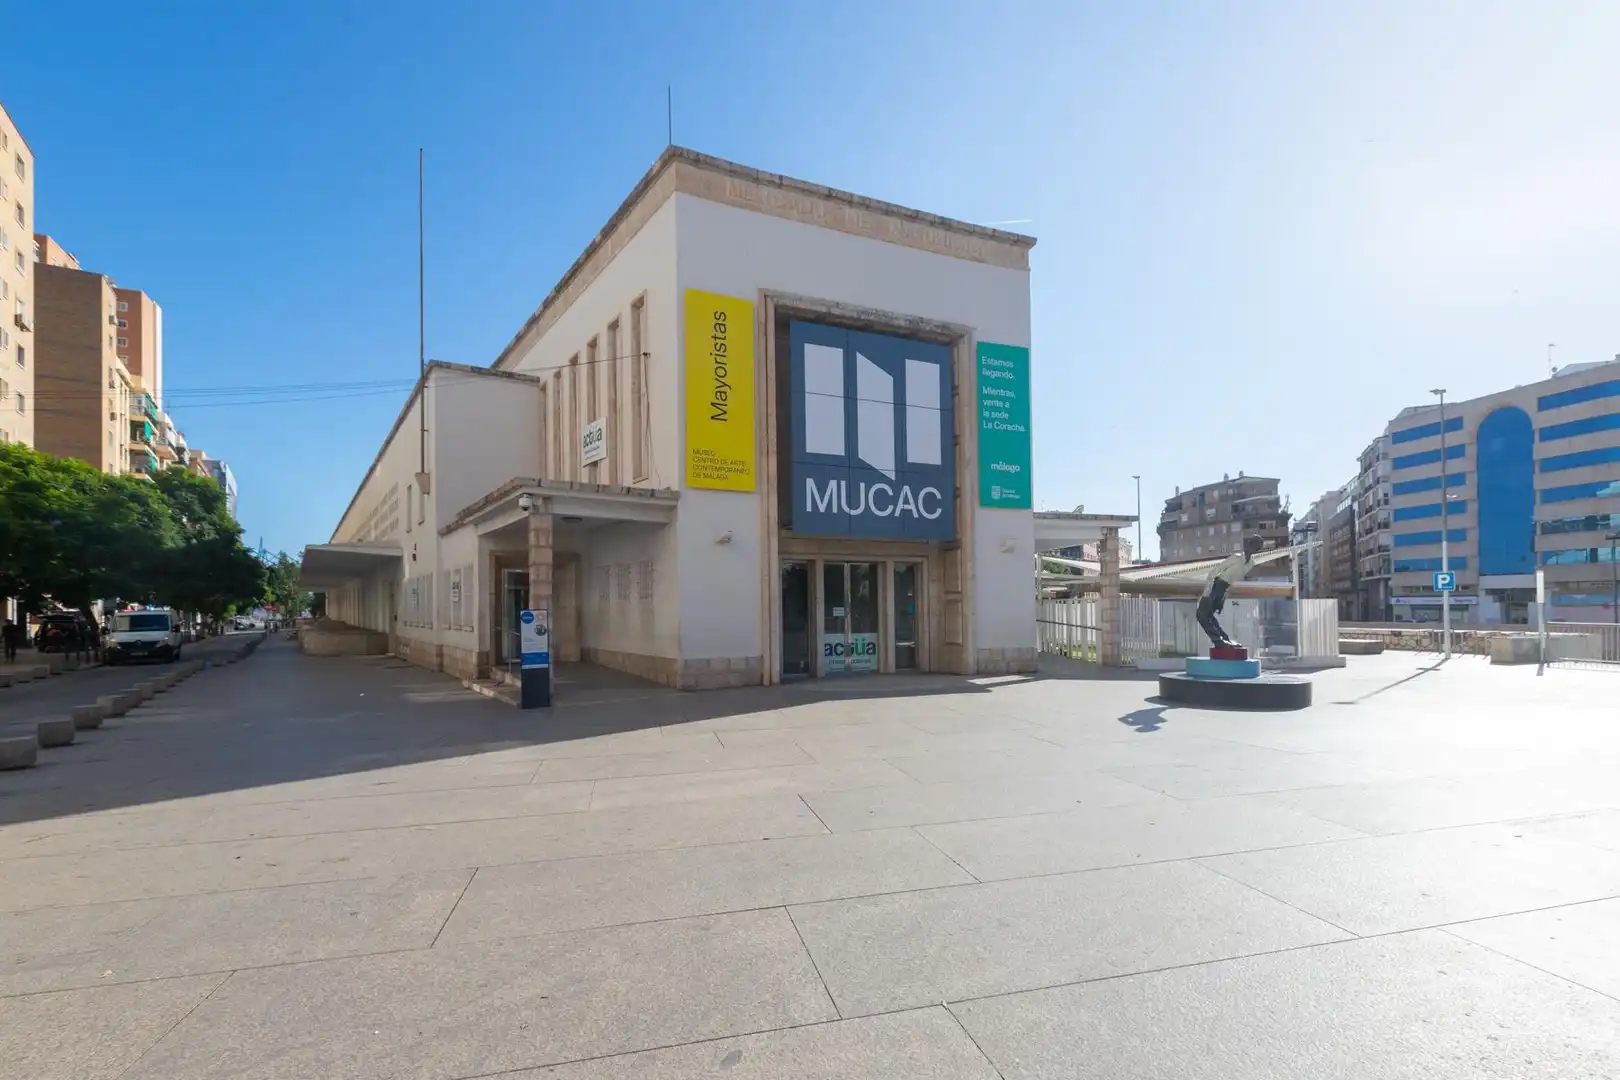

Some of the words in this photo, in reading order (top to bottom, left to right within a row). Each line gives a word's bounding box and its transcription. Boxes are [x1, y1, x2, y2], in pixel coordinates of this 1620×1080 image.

[710, 310, 732, 422] Mayoristas
[982, 356, 1014, 368] Estamos
[983, 399, 1003, 408] vente
[1004, 401, 1010, 409] a
[983, 408, 990, 418] la
[991, 410, 1009, 420] sede
[983, 420, 993, 429] La
[805, 477, 942, 519] MUCAC
[1438, 574, 1450, 588] P
